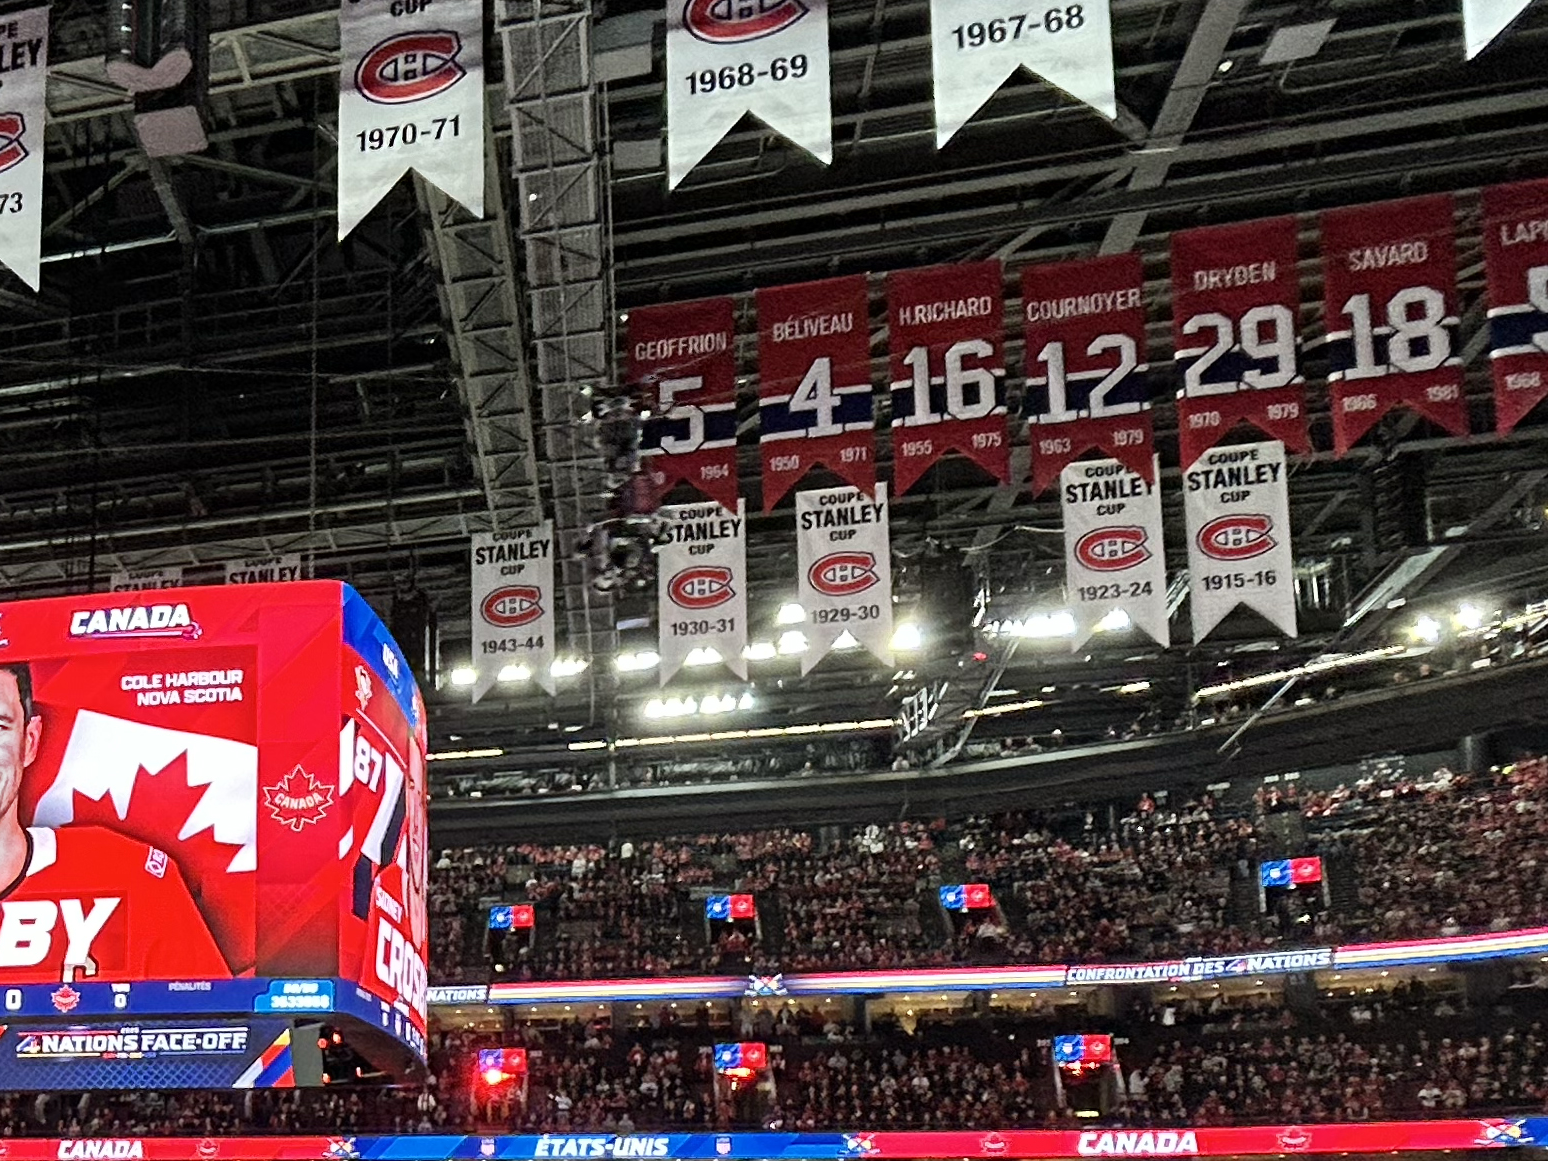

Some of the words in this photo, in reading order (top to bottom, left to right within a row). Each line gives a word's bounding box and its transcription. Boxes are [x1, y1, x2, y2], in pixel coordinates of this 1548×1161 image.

[951, 5, 1086, 51] 1967-68
[686, 53, 809, 96] 1968-69
[355, 114, 462, 153] 1970-71
[1348, 240, 1428, 273] SAVARD
[1193, 260, 1277, 291] DRYDEN
[898, 295, 993, 327] H.RICHARD
[1026, 287, 1142, 323] COURNOYER
[772, 311, 853, 343] BÉLIVEAU
[1341, 285, 1452, 381] 18
[635, 332, 727, 361] GEOFFRION
[1182, 304, 1298, 398] 29
[903, 338, 997, 427] 16
[1036, 333, 1140, 424] 12
[788, 357, 843, 438] 4
[659, 375, 704, 454] 5
[1266, 402, 1299, 421] 1979
[1039, 437, 1071, 454] 1963
[1113, 429, 1144, 447] 1979
[840, 446, 868, 463] 1971
[1208, 448, 1259, 466] COUPE
[1187, 461, 1282, 492] STANLEY
[1096, 502, 1126, 516] CUP
[1220, 489, 1251, 504] CUP
[679, 506, 722, 520] COUPE
[801, 503, 884, 531] STANLEY
[829, 528, 857, 542] CUP
[475, 539, 550, 567] STANLEY
[689, 542, 715, 556] CUP
[500, 563, 525, 577] CUP
[1202, 570, 1277, 590] 1915-16
[1079, 581, 1153, 601] 1923-24
[70, 603, 191, 636] CANADA
[811, 605, 880, 625] 1929-30
[671, 619, 736, 637] 1930-31
[481, 636, 545, 654] 1943-44
[121, 673, 163, 690] COLE
[165, 669, 243, 687] HARBOUR
[137, 690, 181, 706] NOVA
[183, 686, 243, 704] SCOTIA
[354, 736, 384, 792] 87
[274, 792, 324, 810] CANADA
[1067, 962, 1190, 981] CONFRONTATION
[1194, 957, 1224, 975] DES
[1246, 952, 1331, 971] NATIONS
[5, 988, 22, 1011] 0
[427, 989, 486, 1000] NATIONS
[40, 1033, 138, 1053] NATIONS
[57, 1139, 144, 1161] CANADA
[534, 1133, 669, 1158] ÉTATS-UNIS
[1078, 1131, 1198, 1156] CANADA
